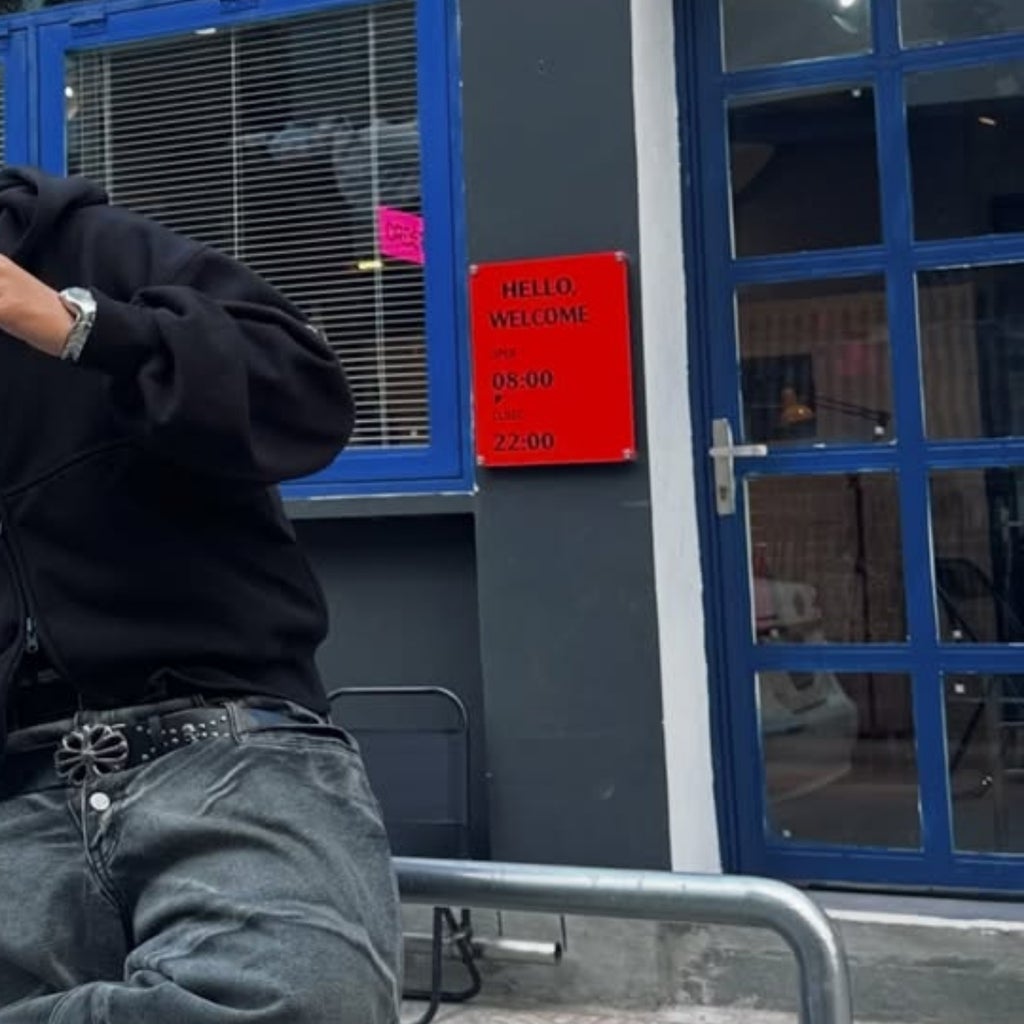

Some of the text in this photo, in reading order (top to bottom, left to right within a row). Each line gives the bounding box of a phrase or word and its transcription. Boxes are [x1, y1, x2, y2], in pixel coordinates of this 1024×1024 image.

[503, 278, 575, 298] HELLO,
[490, 307, 588, 328] WELCOME
[493, 371, 553, 390] 08:00
[495, 433, 554, 451] 22:00
